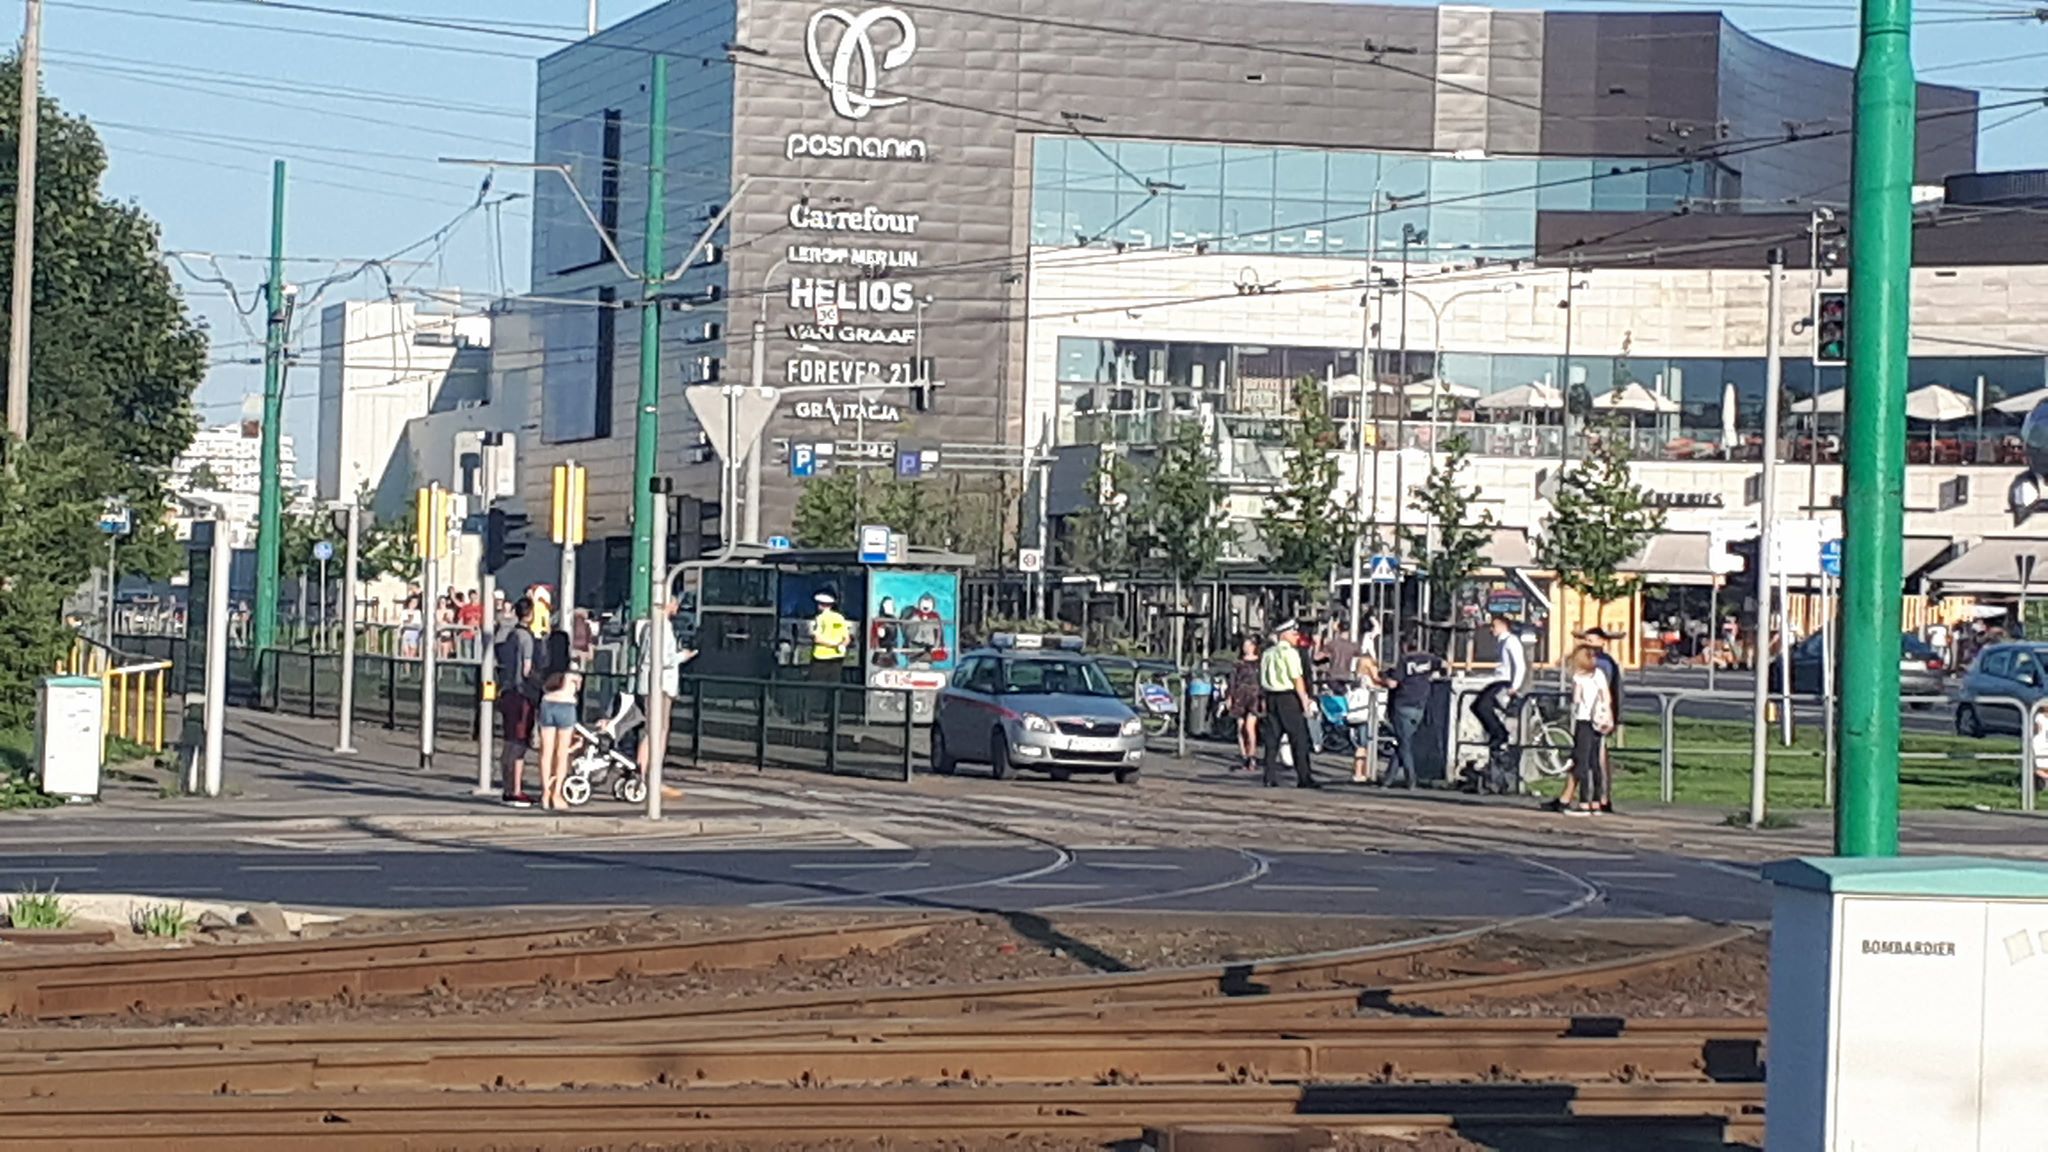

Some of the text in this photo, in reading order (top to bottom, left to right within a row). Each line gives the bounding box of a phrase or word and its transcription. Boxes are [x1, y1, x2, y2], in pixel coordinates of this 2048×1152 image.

[789, 203, 920, 233] Carrefour
[850, 248, 918, 267] MERLIN
[790, 277, 914, 311] HELIOS
[838, 326, 916, 344] GRAAF
[787, 359, 912, 385] FOREVER 21
[1861, 939, 1956, 957] BOMBARDIER
